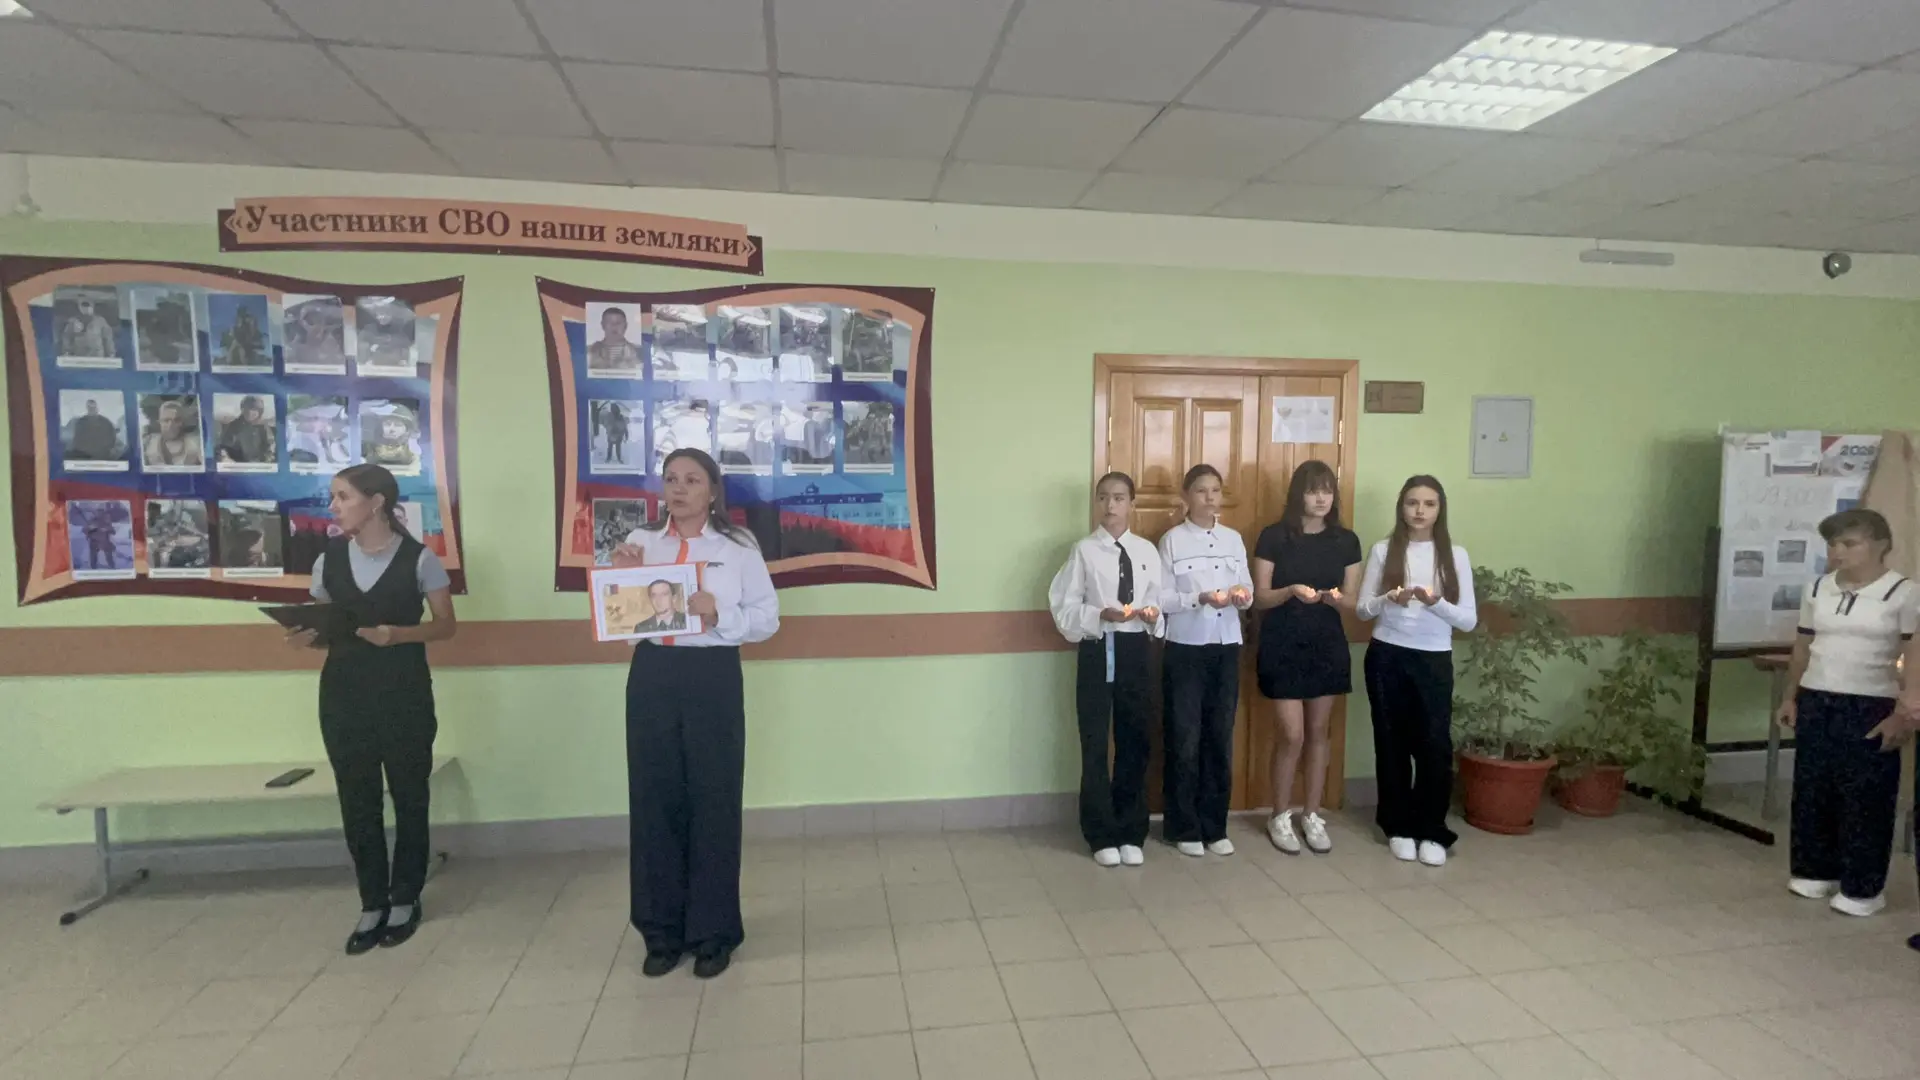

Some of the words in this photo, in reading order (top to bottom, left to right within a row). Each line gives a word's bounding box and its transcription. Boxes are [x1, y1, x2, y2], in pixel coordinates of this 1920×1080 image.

[224, 204, 428, 234] «Участники
[438, 208, 510, 237] СВО
[520, 220, 607, 242] наши
[615, 226, 757, 257] земляки»
